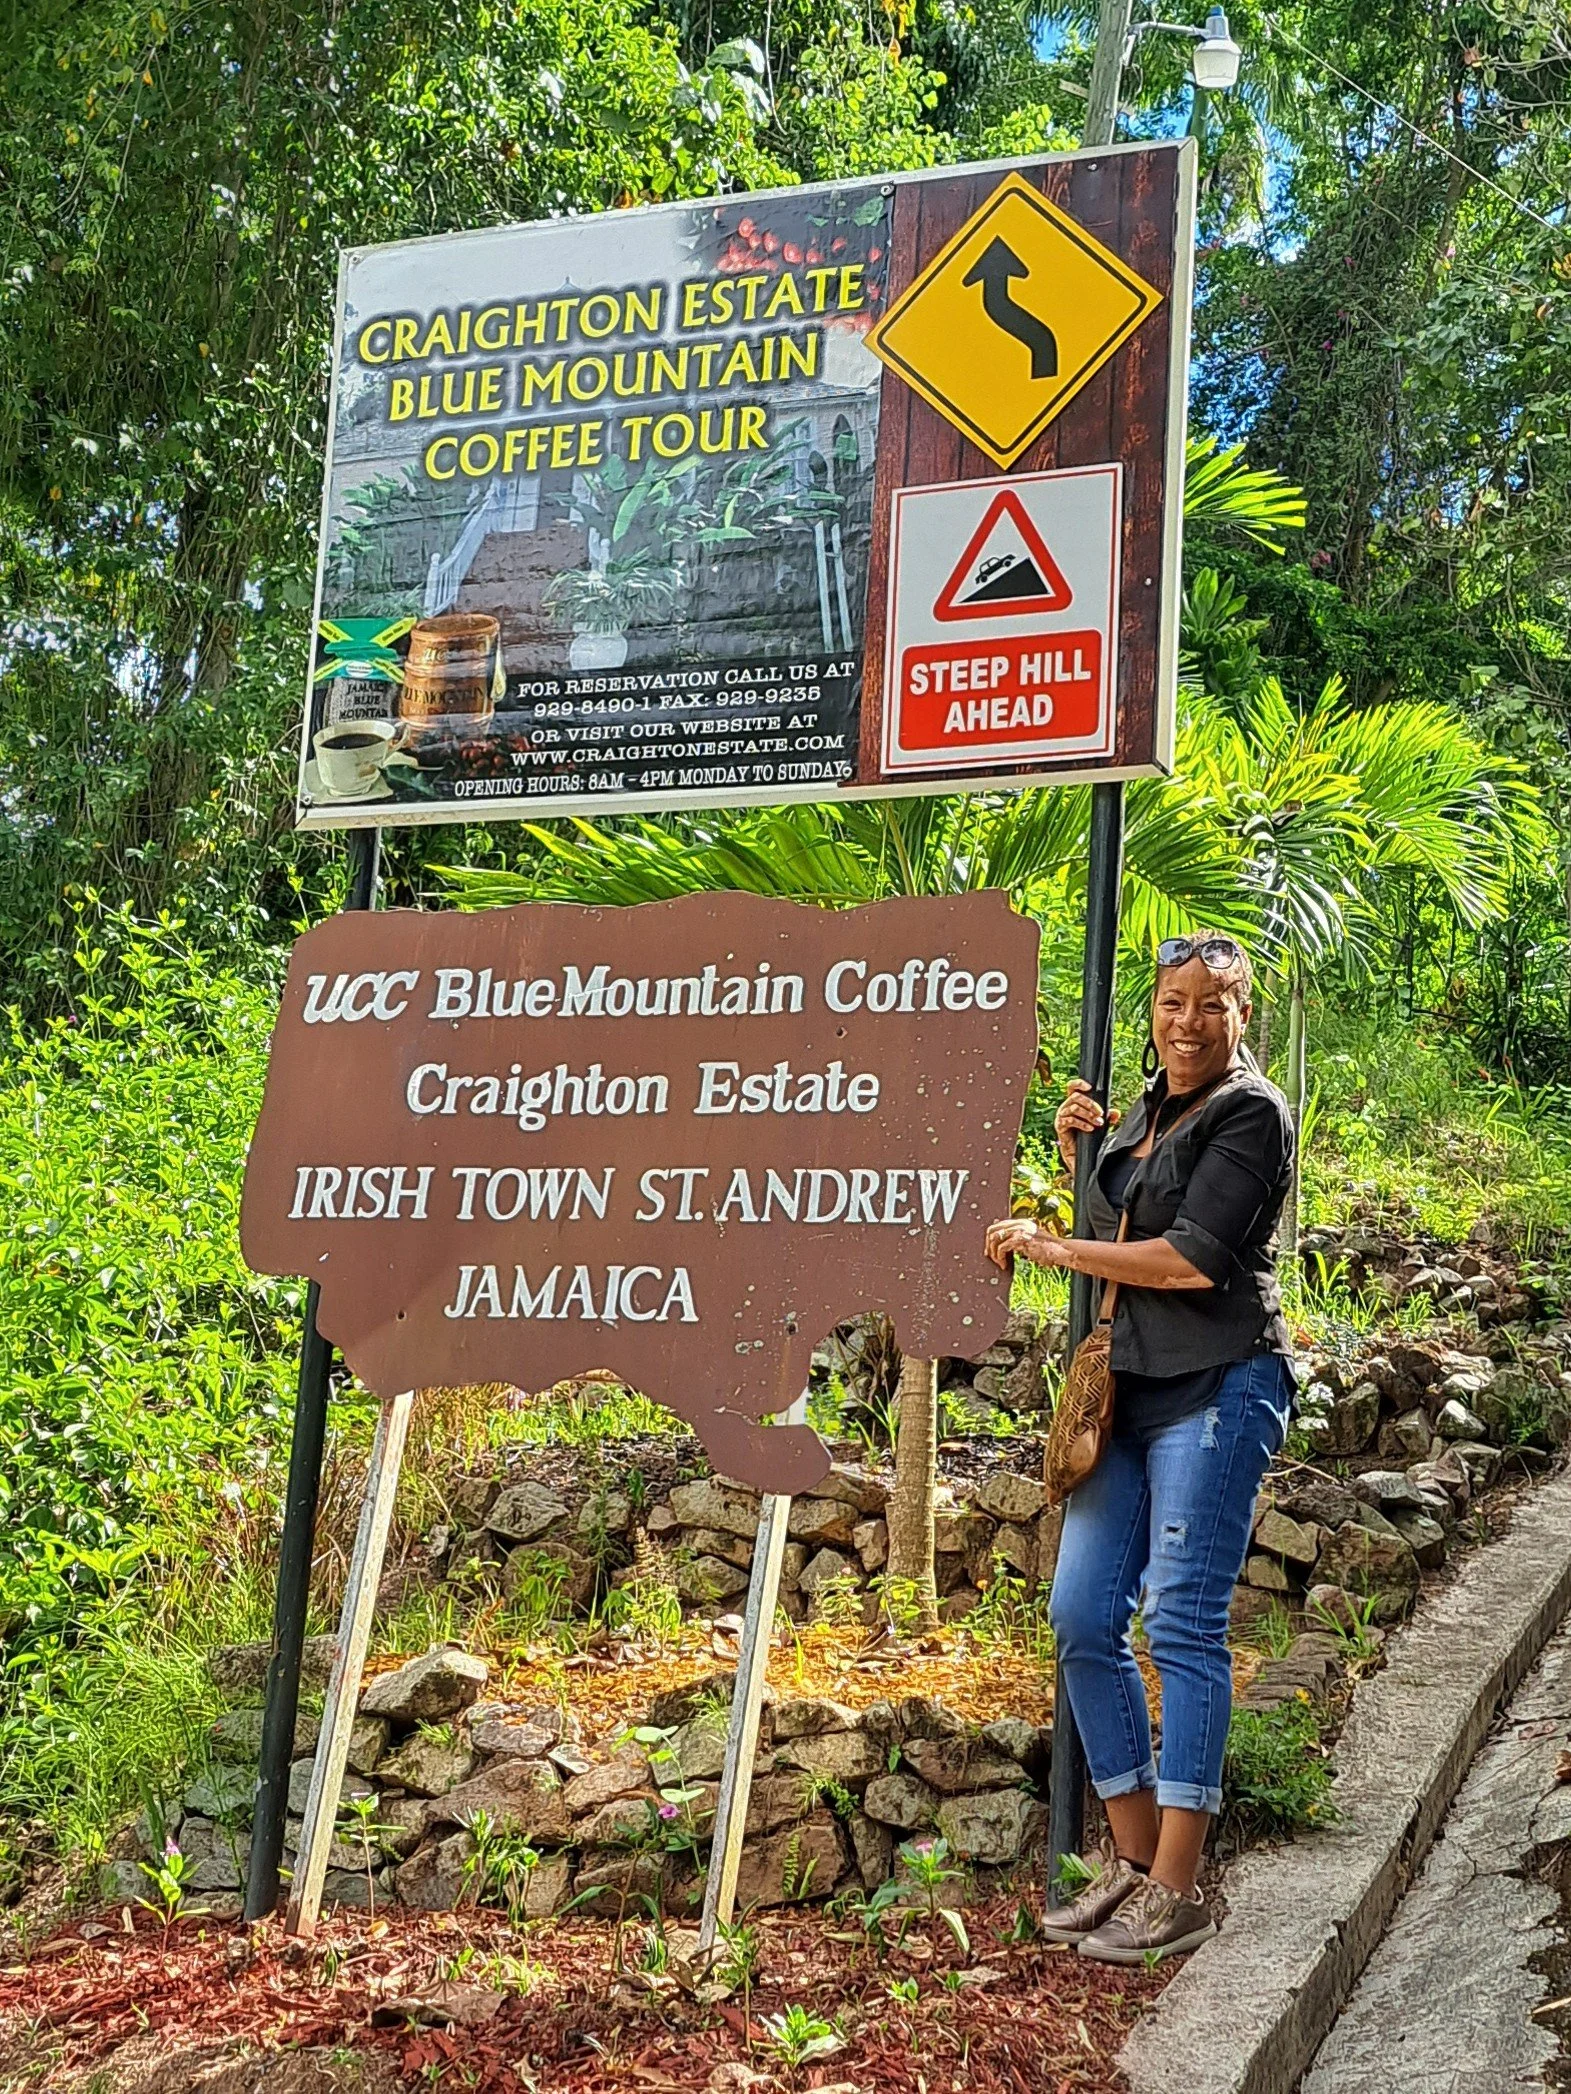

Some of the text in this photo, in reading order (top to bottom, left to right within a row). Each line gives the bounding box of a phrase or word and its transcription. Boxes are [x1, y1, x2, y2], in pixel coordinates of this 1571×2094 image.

[358, 264, 865, 365] CRAIGHTON ESTATE
[388, 331, 819, 421] BLUE MOUNTAIN
[424, 406, 769, 482] COFFEE TOUR
[517, 662, 855, 698] FOR RESERVATION CALL US AT
[909, 649, 1091, 696] STEEP HILL
[534, 686, 821, 718] 929-8490-1 FAX: 929-9235
[943, 694, 1053, 733] AHEAD
[511, 735, 845, 766] WWW.CRAIGHTONESTATE.COM
[531, 714, 818, 744] OR VISIT OUR WEBSITE AT
[455, 778, 524, 797] OPENING
[526, 774, 585, 794] HOURS:
[588, 772, 625, 790] 8AM
[640, 769, 675, 787] 4PM
[678, 766, 750, 786] MONDAY
[753, 764, 774, 781] TO
[303, 969, 420, 1024] UCC
[824, 957, 1009, 1014] Coffee
[406, 1060, 880, 1131] Craighton Estate
[287, 1166, 435, 1220] IRISH
[452, 1167, 616, 1221] TOWN
[444, 1264, 700, 1323] JAMAICA
